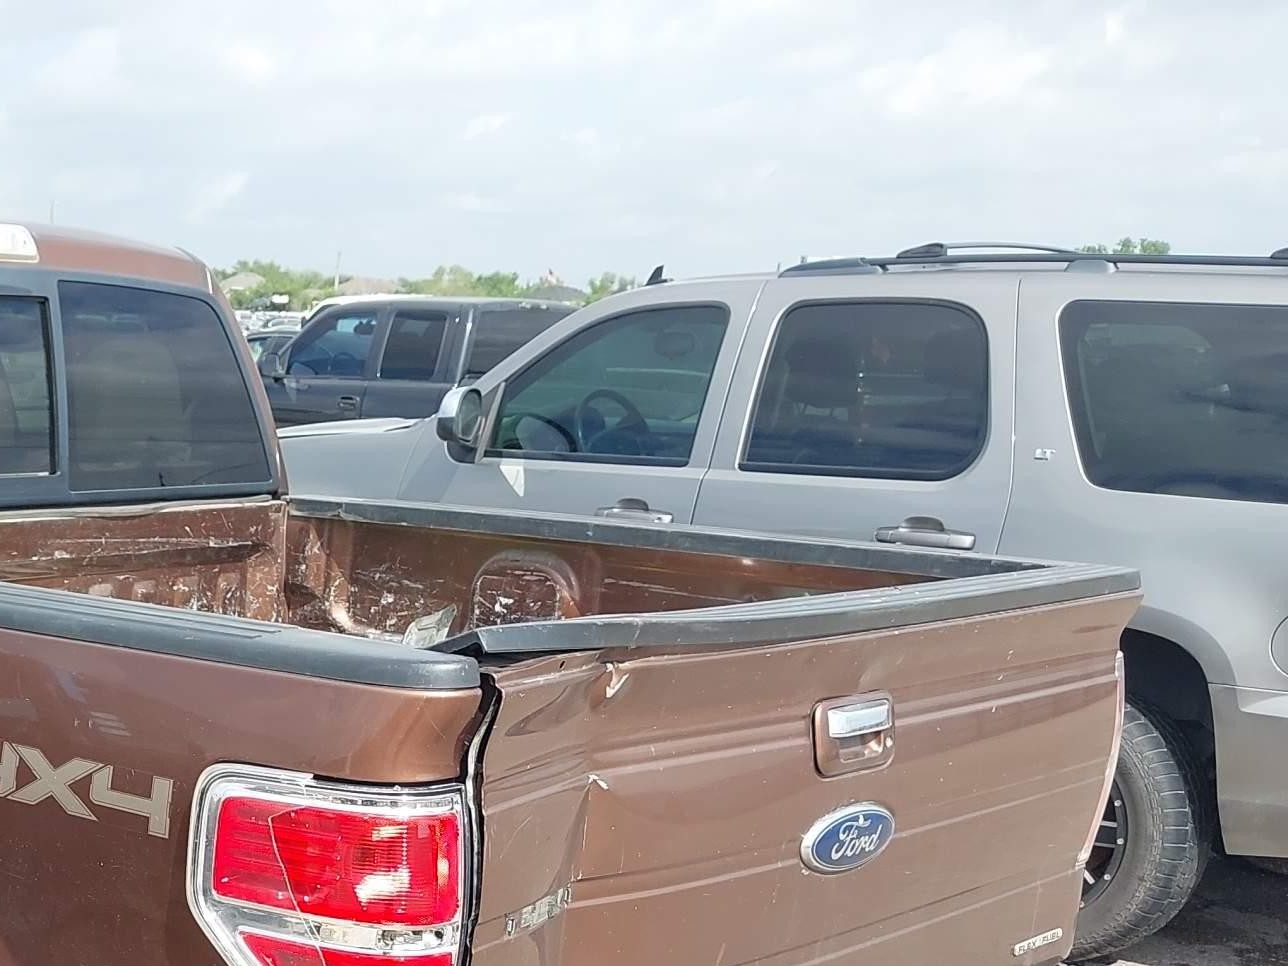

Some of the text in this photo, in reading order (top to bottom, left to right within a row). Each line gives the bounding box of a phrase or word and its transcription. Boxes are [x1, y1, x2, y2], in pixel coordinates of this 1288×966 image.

[1034, 448, 1056, 460] LT
[831, 815, 883, 860] Ford
[1042, 931, 1060, 944] FUEL
